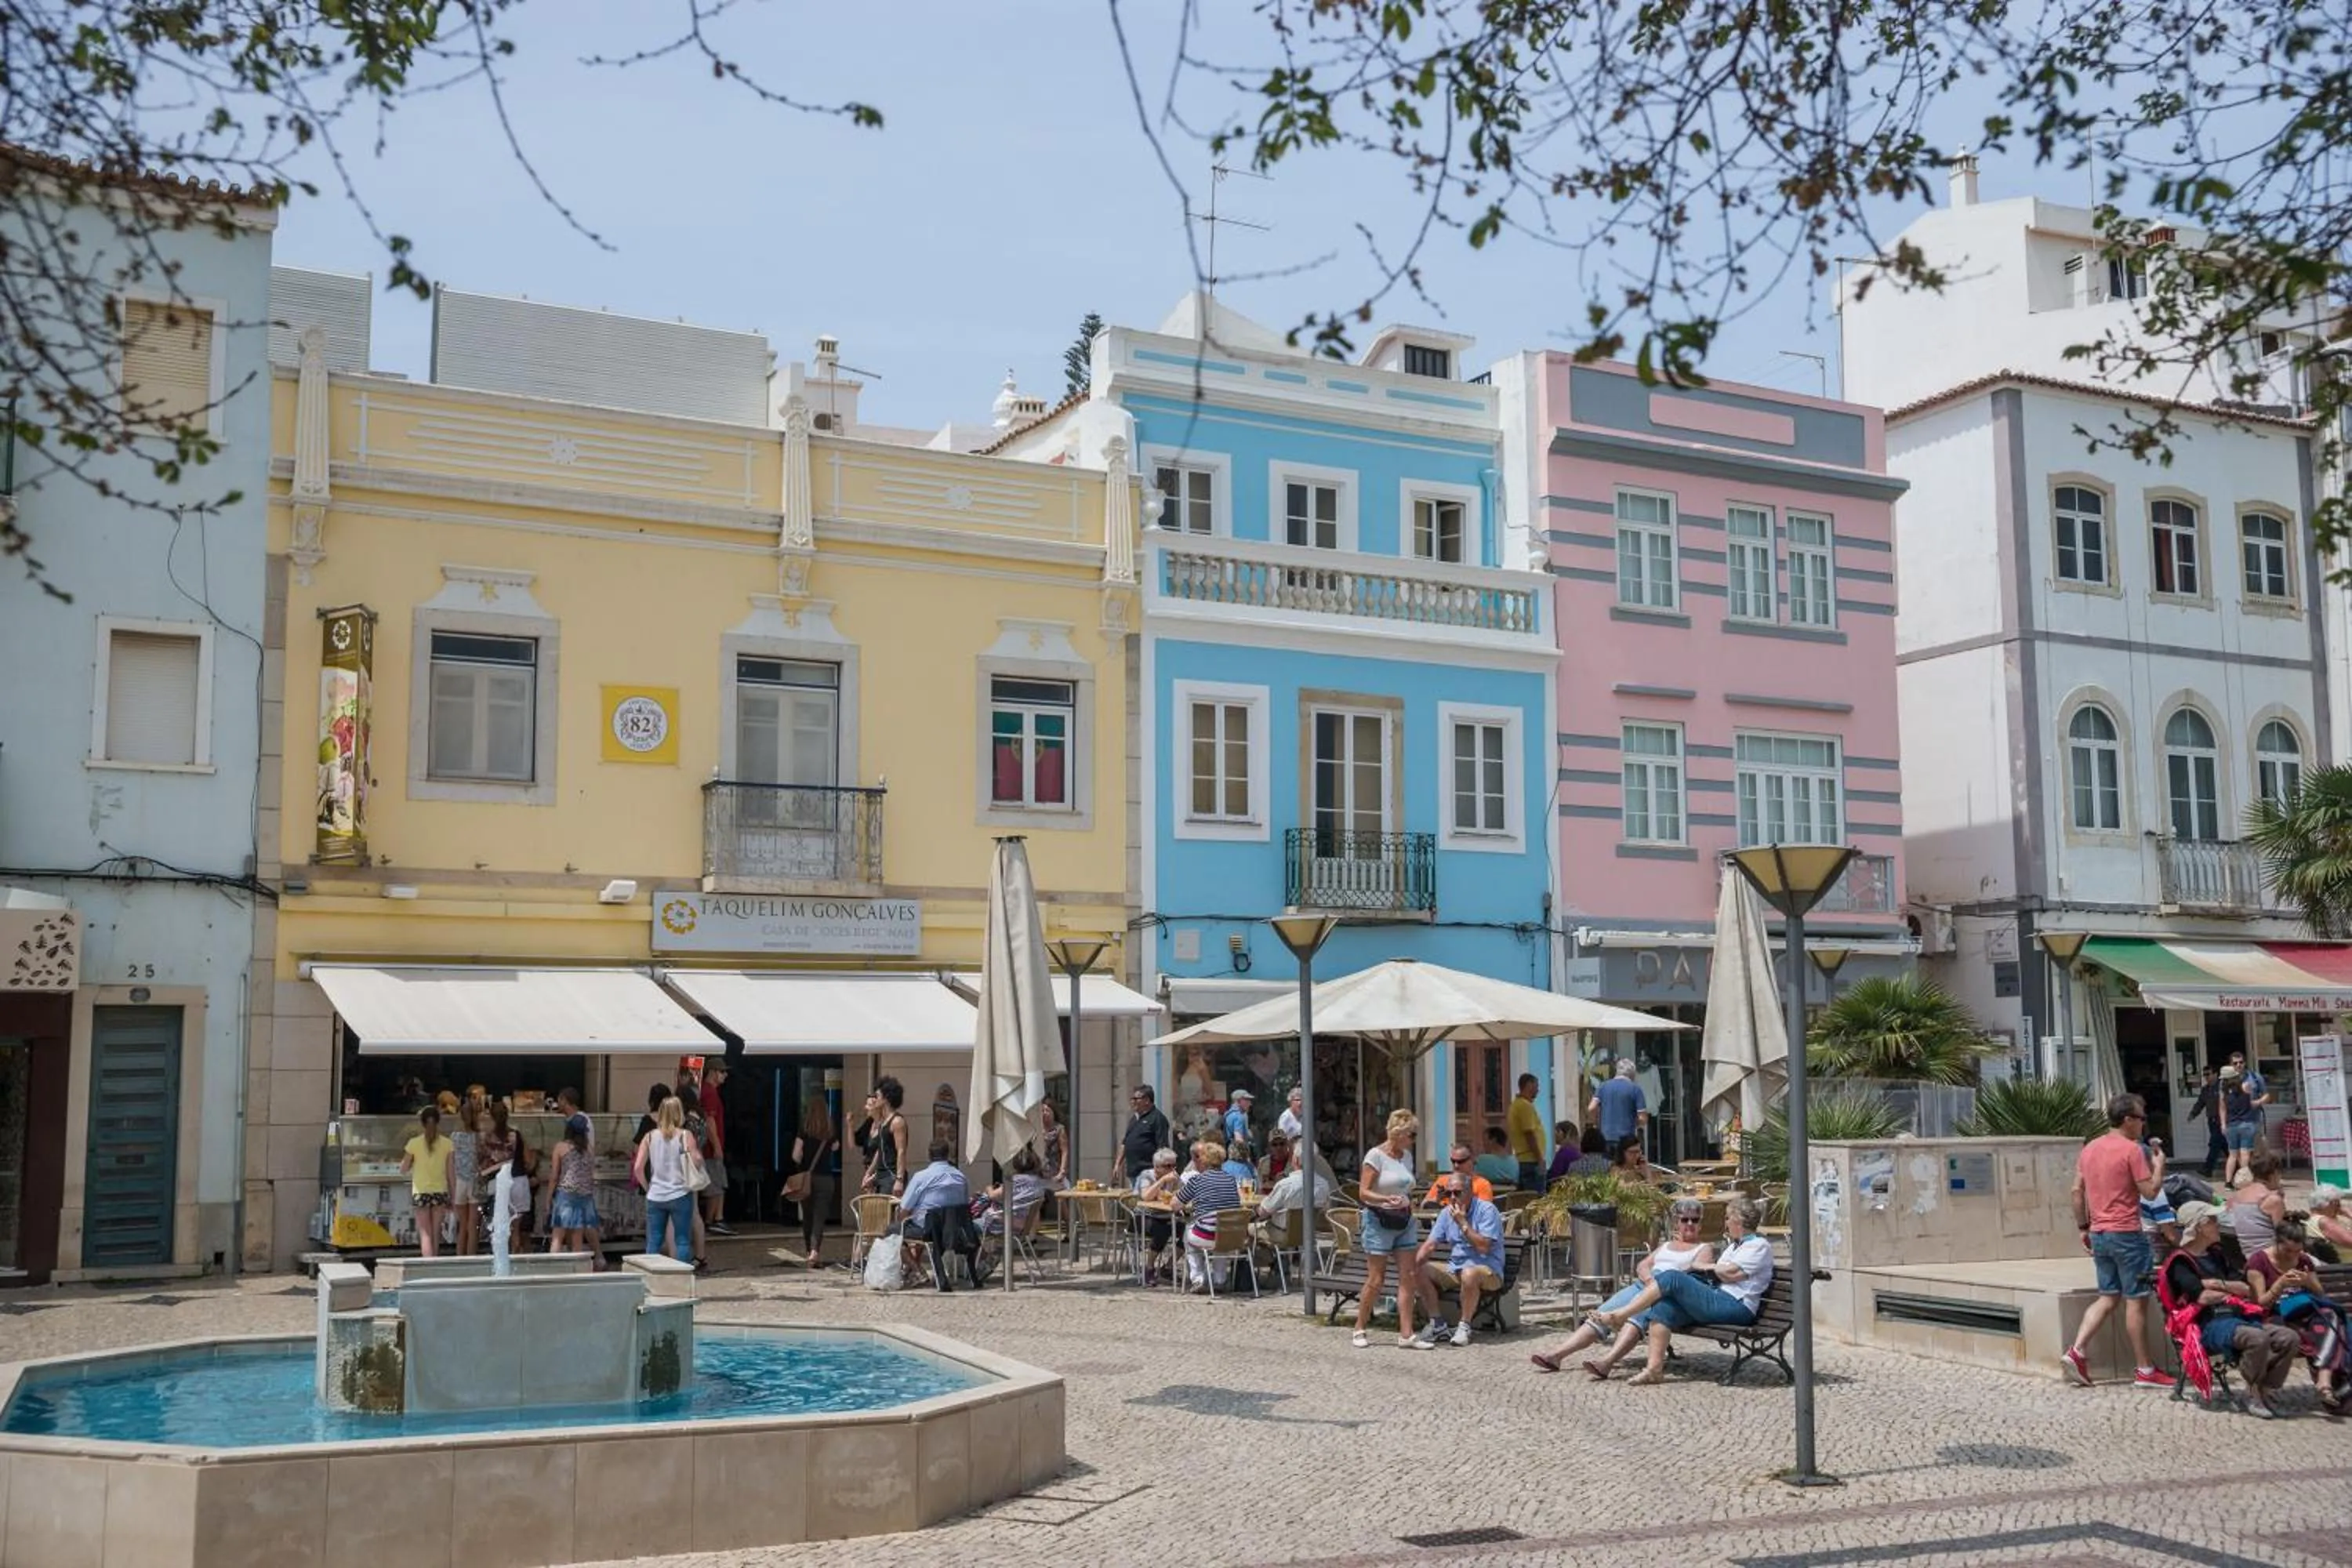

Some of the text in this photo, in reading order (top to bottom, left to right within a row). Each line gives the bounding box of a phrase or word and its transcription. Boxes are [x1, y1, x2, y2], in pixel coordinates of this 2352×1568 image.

[630, 717, 651, 732] 82
[699, 898, 915, 921] TAQUELIM GONÇALVES
[815, 926, 850, 937] OCES
[854, 927, 915, 939] REGINAIS
[127, 964, 155, 979] 25
